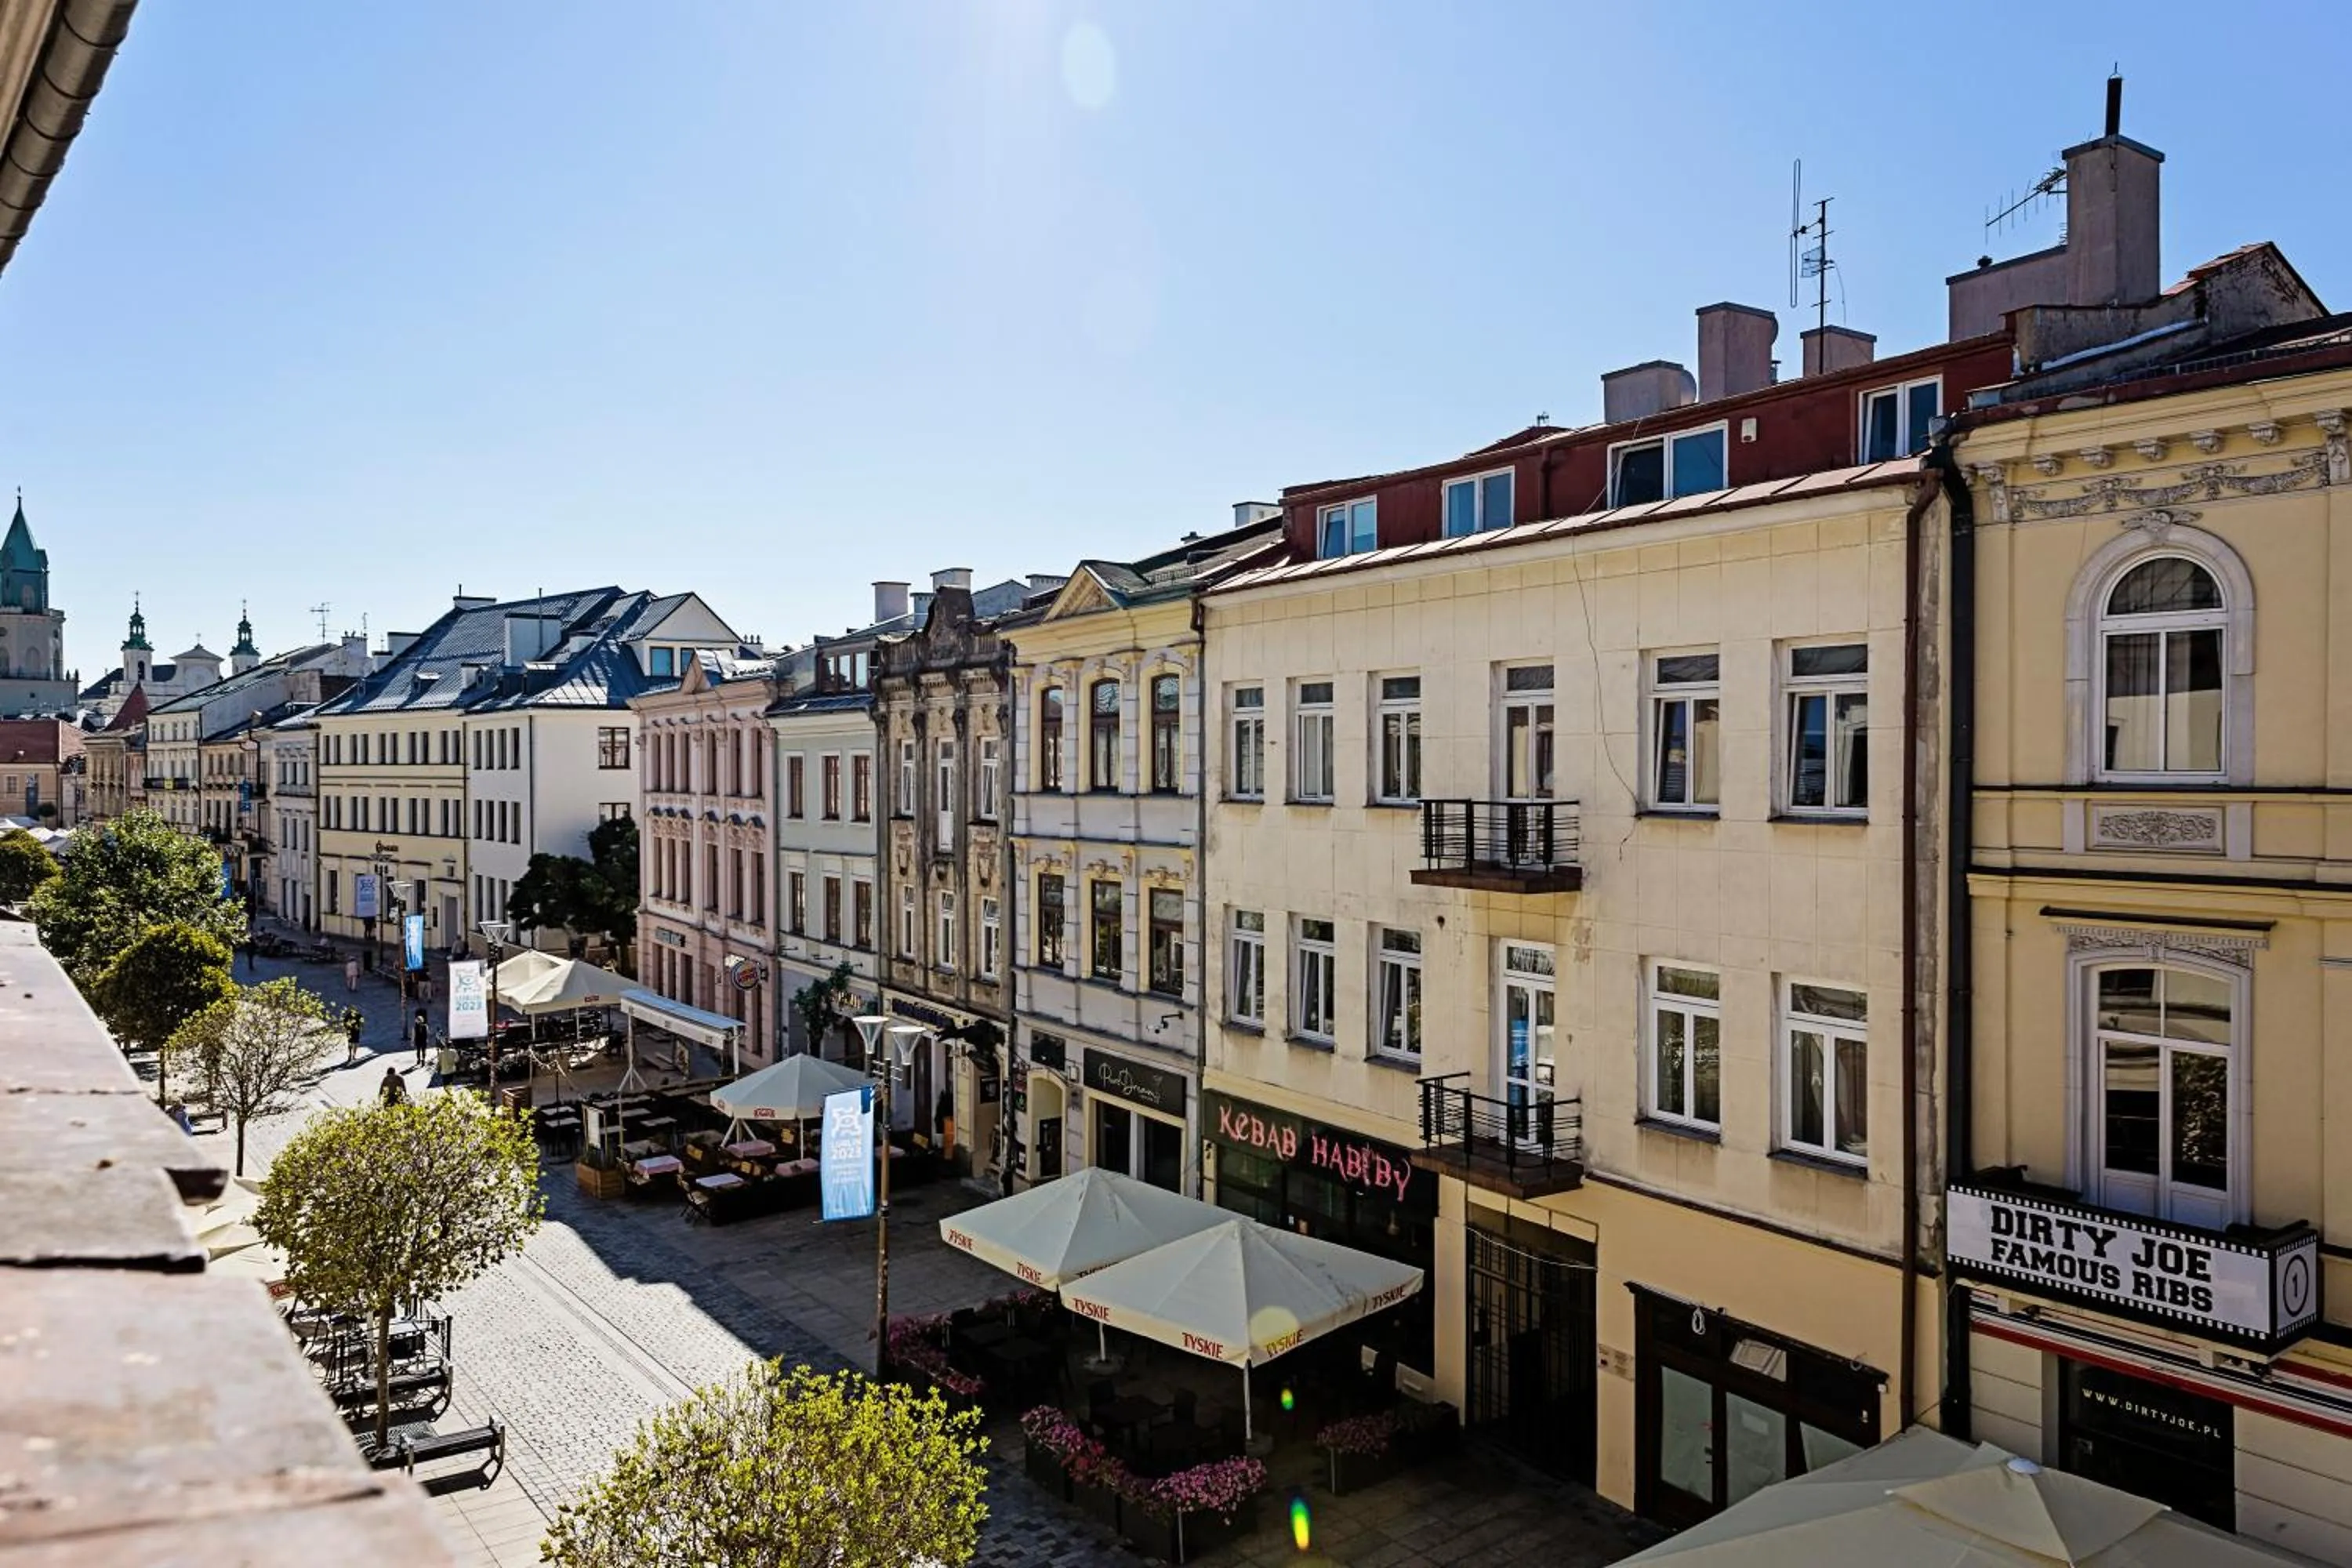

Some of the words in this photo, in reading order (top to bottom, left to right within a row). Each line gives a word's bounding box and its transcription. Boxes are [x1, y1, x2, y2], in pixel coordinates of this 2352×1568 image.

[949, 1229, 973, 1250] TYSKIE
[1991, 1205, 2117, 1258] DIRTY
[2132, 1237, 2211, 1283] JOE
[1017, 1261, 1042, 1284] TYSKIE
[1991, 1238, 2120, 1290] FAMOUS
[2132, 1271, 2213, 1313] RIBS
[1073, 1298, 1110, 1322] TYSKIE
[1372, 1284, 1406, 1309] TYSKIE
[1182, 1332, 1223, 1359] TYSKIE
[1265, 1329, 1304, 1357] TYSKIE
[2082, 1388, 2221, 1438] WWW.DIRTYJOE.PL
